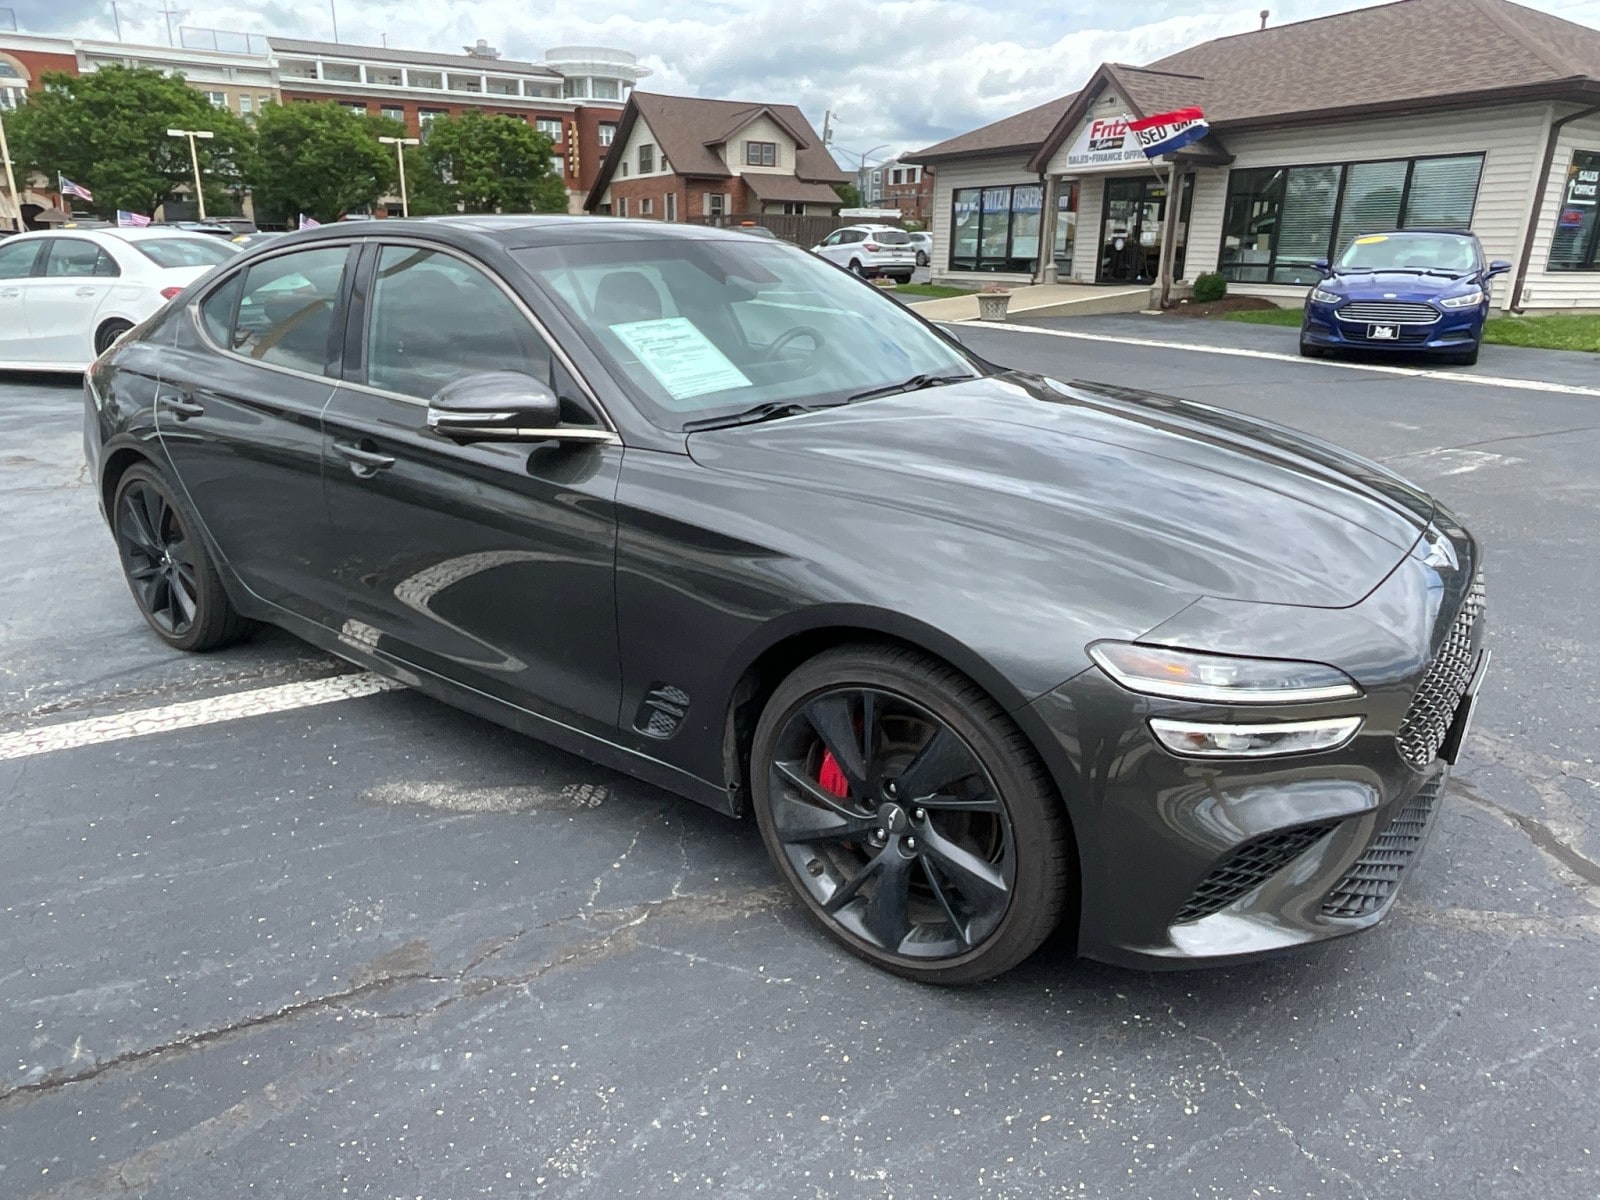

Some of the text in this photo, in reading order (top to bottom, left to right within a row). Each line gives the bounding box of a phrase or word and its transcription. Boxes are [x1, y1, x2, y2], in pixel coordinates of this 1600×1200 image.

[1090, 120, 1128, 138] Fritz
[1123, 149, 1146, 160] OFFIC
[1574, 184, 1597, 195] OFFICE
